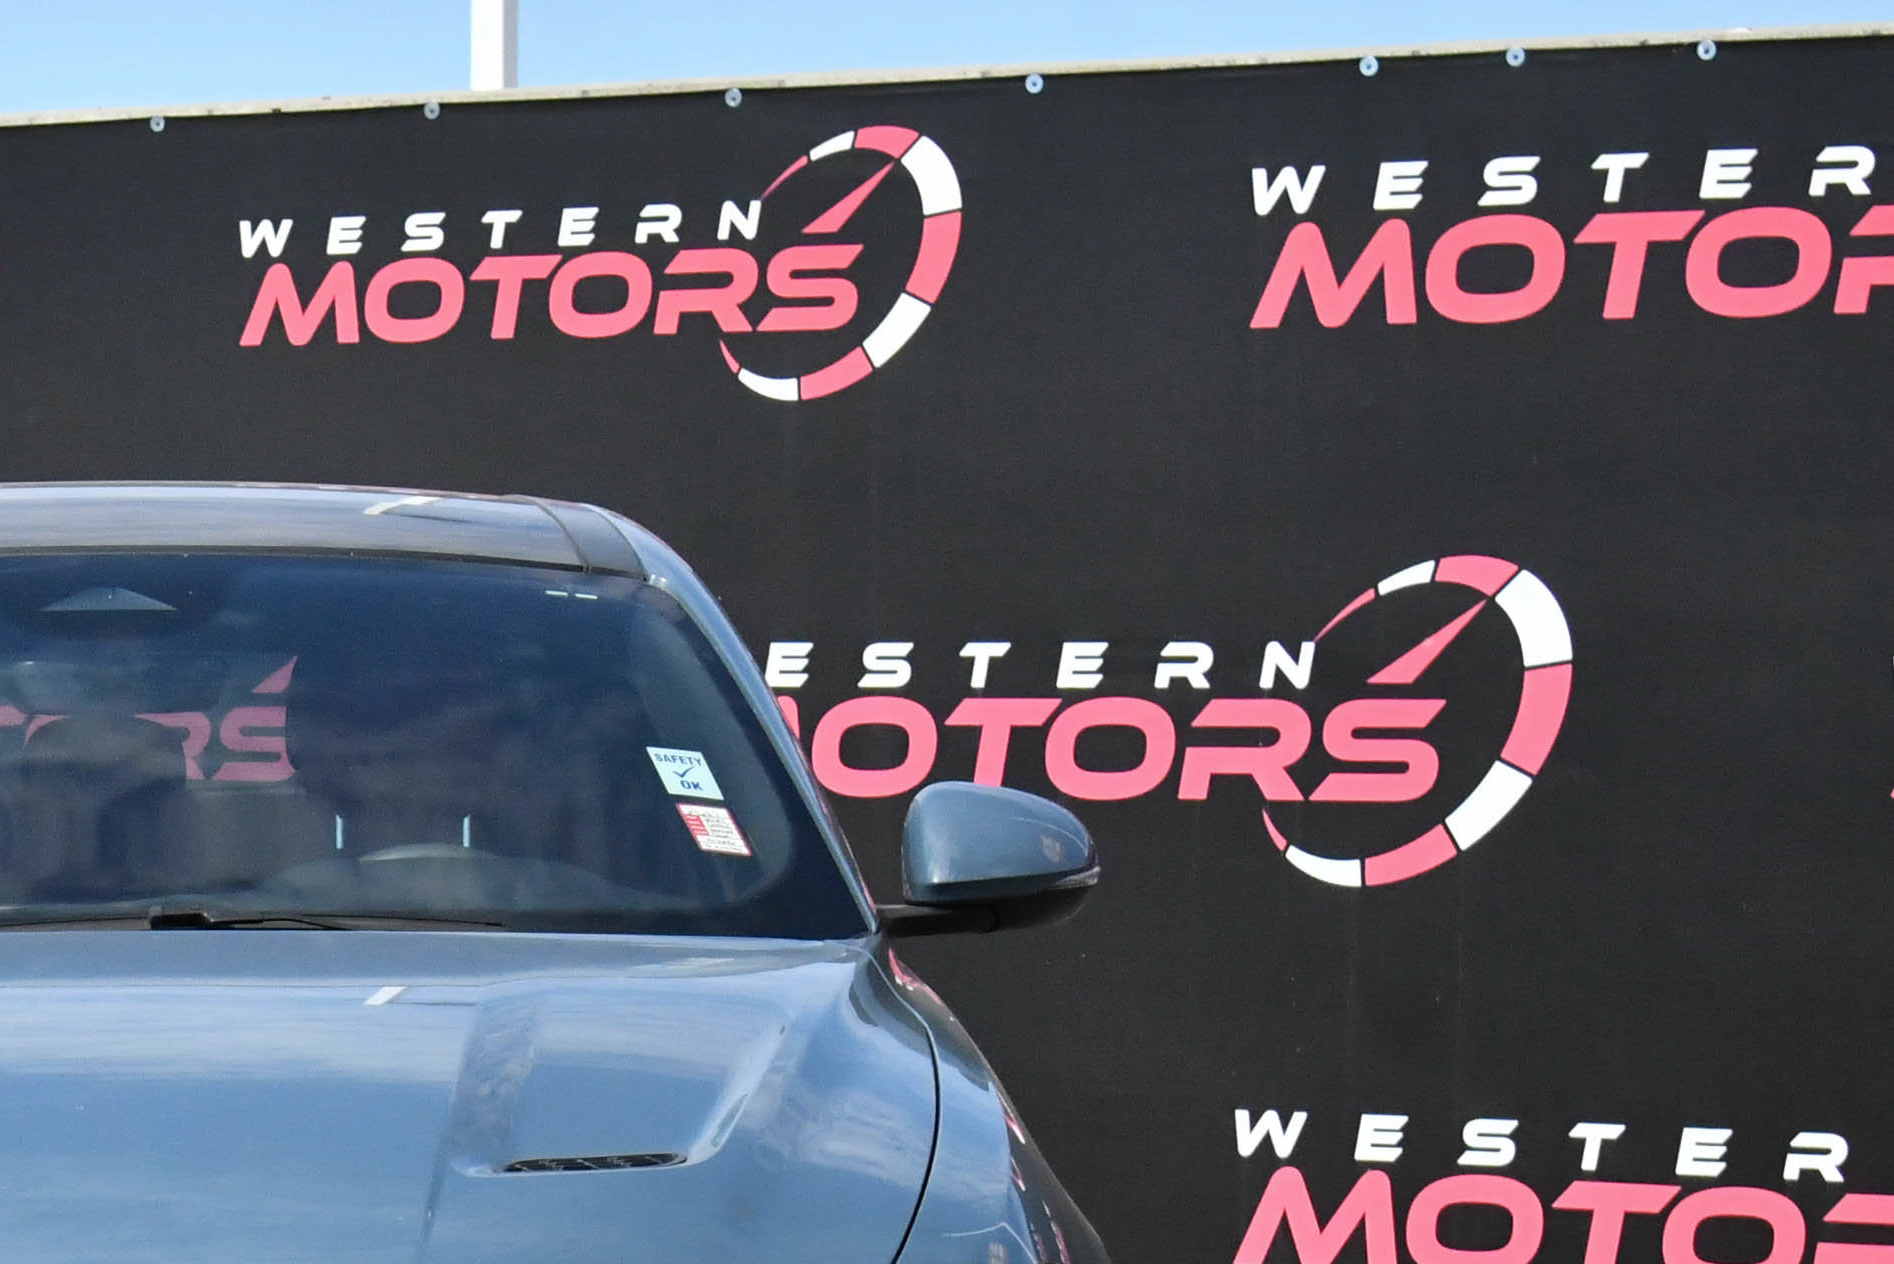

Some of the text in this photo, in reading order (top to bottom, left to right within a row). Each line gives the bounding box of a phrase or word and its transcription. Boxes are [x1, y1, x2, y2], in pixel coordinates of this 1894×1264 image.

[240, 200, 761, 259] WESTERN
[240, 243, 863, 346] MOTORS
[765, 641, 1315, 690] ESTERN
[654, 752, 703, 767] SAFETY
[777, 695, 1446, 802] OTORS
[680, 779, 704, 791] OK
